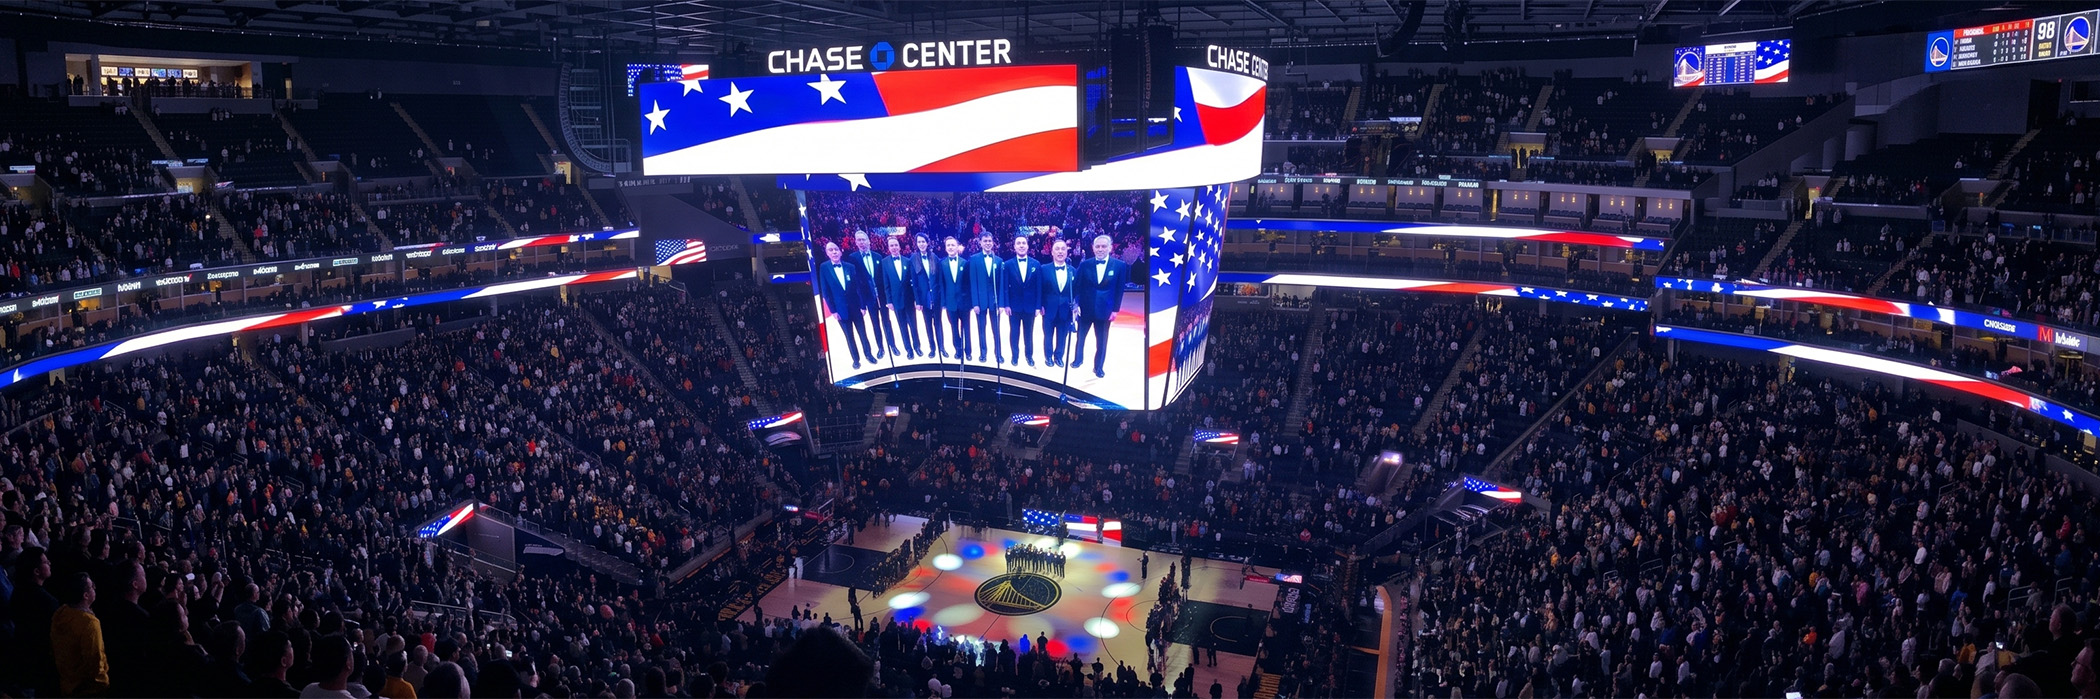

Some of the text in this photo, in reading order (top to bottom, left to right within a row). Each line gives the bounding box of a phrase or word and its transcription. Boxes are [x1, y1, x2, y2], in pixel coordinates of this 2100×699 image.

[2038, 21, 2056, 40] 98
[768, 39, 1011, 73] CHASE CENTER
[1207, 45, 1250, 73] CHASE
